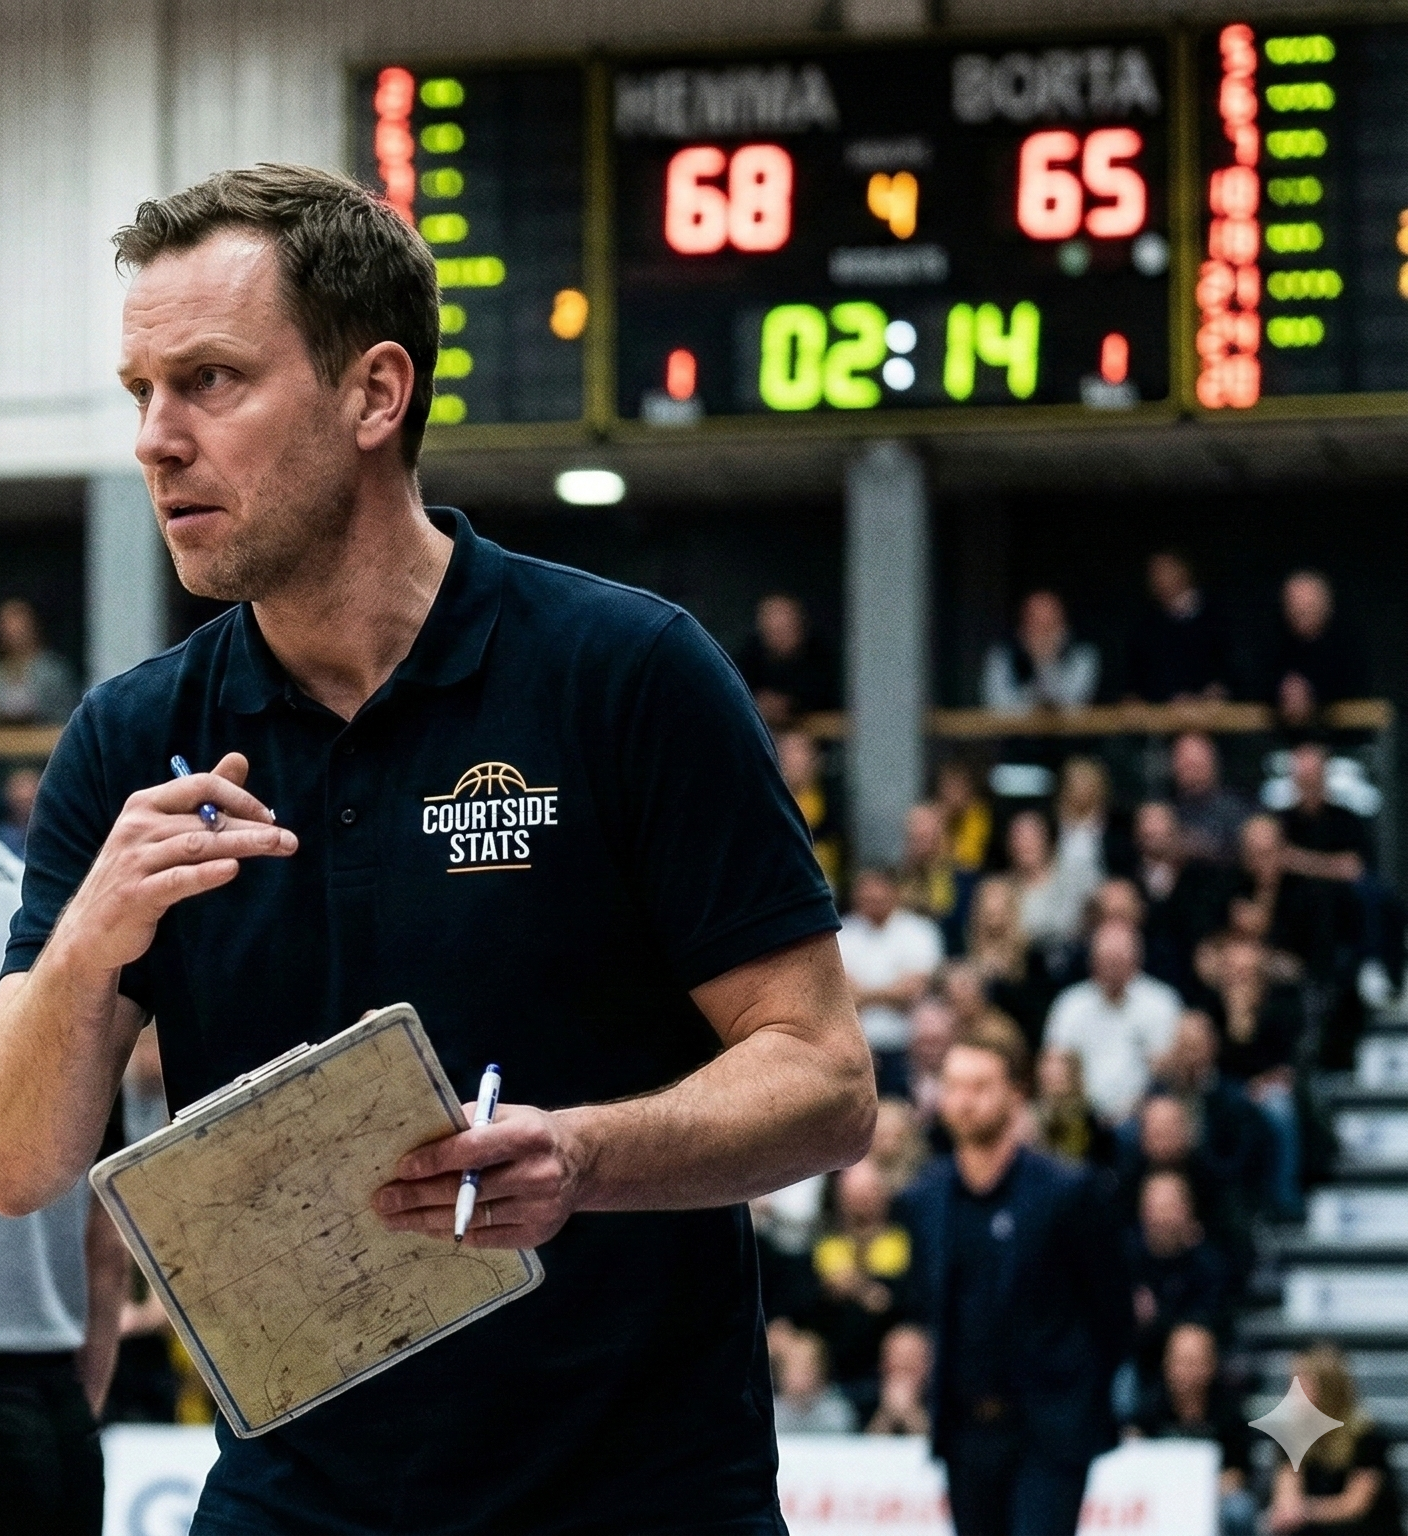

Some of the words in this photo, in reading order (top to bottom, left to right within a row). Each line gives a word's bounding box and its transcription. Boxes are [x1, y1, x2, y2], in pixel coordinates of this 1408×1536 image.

[665, 145, 792, 254] 68
[868, 171, 918, 239] 4
[1018, 128, 1146, 240] 65
[760, 301, 1040, 411] 02:14
[422, 795, 558, 834] COURTSIDE
[449, 829, 531, 863] STATS
